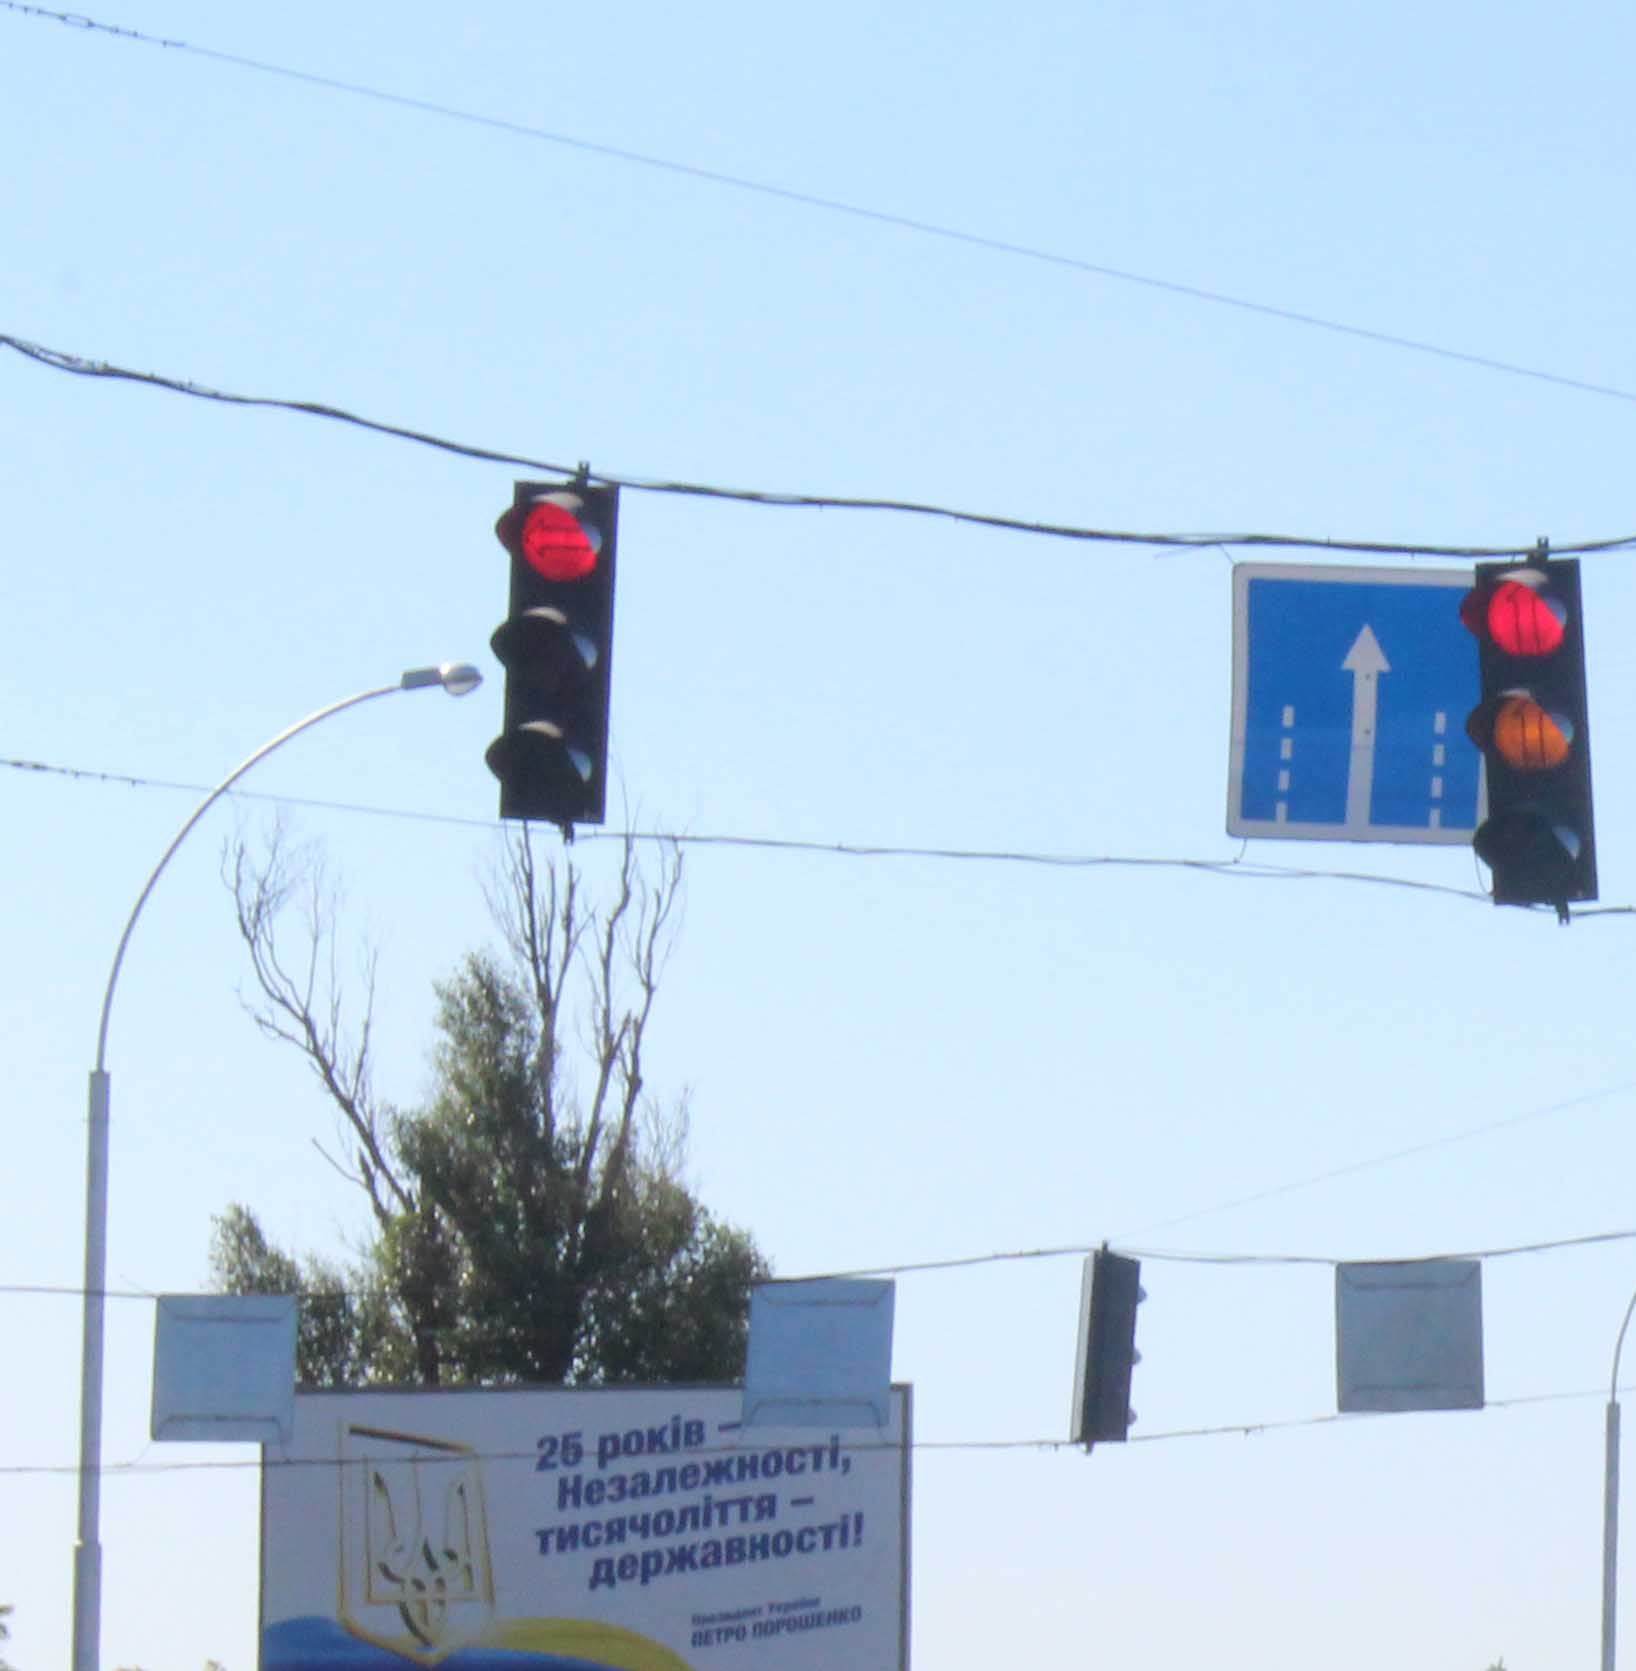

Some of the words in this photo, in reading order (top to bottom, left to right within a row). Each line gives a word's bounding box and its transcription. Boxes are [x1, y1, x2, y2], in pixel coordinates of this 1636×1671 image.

[535, 1431, 583, 1471] 25
[597, 1414, 706, 1469] років
[556, 1433, 851, 1512] Незалежності,
[534, 1494, 778, 1556] тисячоліття
[588, 1511, 865, 1590] державності!
[690, 1624, 747, 1649] ПЕТРО
[751, 1603, 863, 1640] ПОРОШЕНКО
